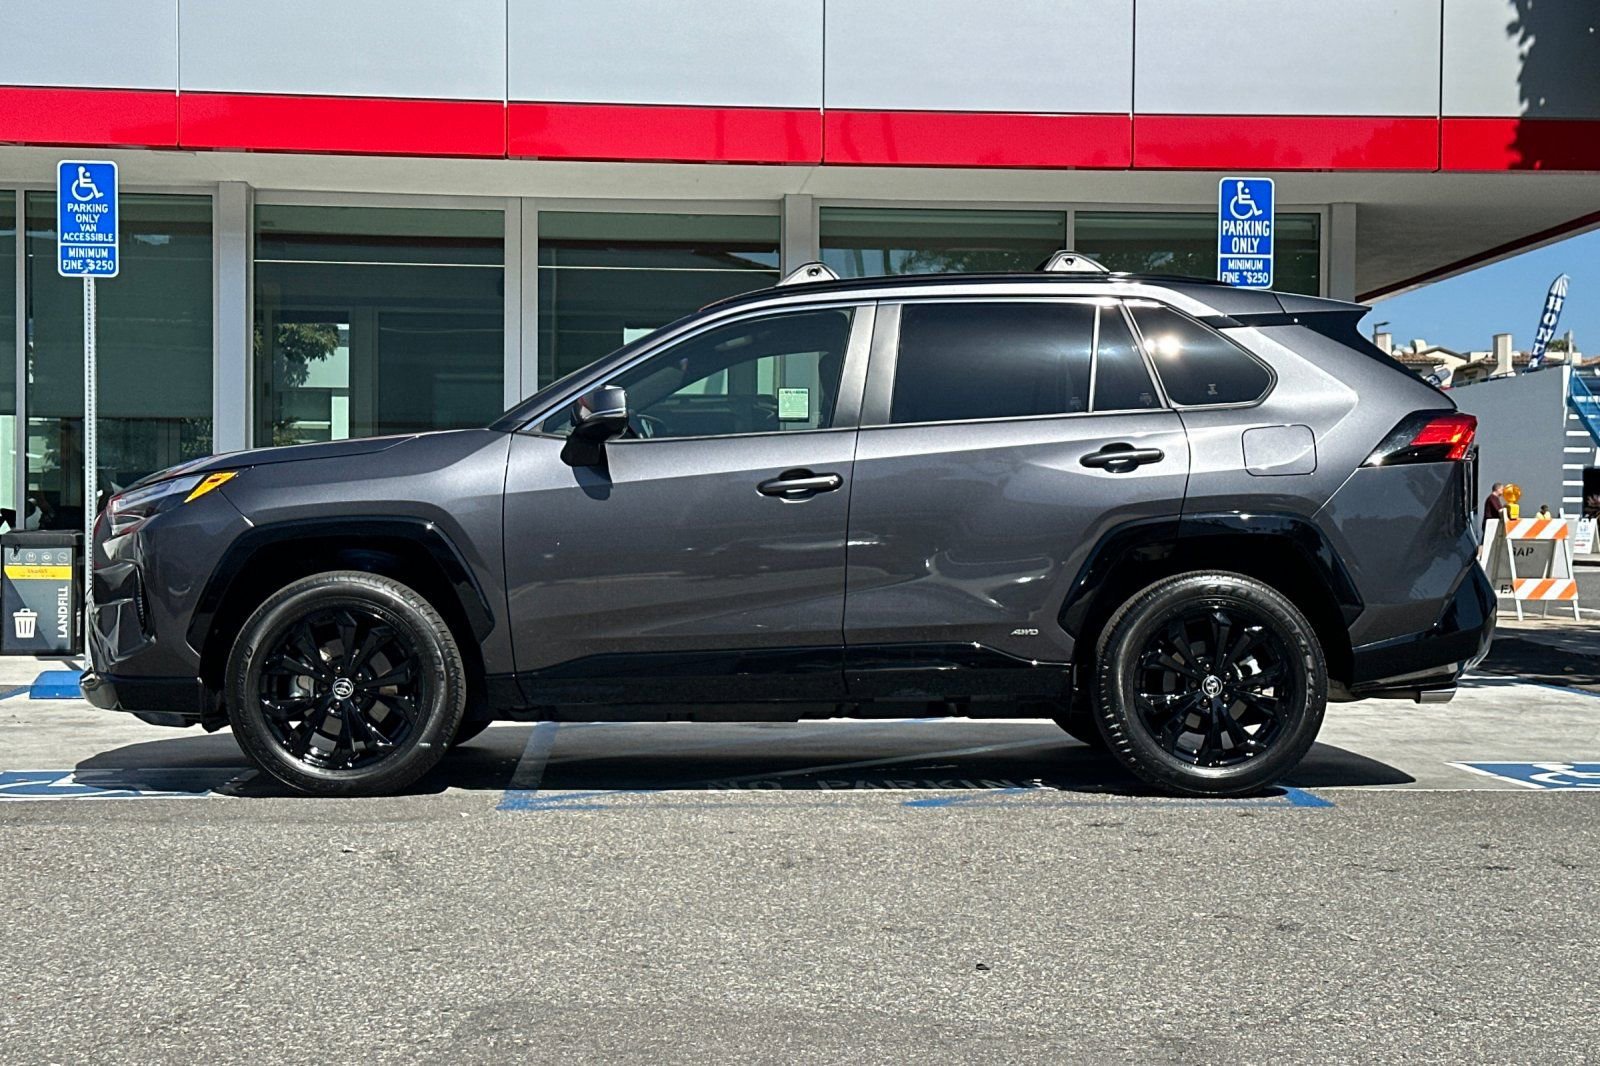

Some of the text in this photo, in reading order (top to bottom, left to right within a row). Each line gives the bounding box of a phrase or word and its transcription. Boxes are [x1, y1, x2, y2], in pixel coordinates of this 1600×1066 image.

[67, 203, 108, 213] PARKING
[75, 214, 100, 223] ONLY
[80, 224, 97, 232] VAN
[1222, 220, 1270, 236] PARKING
[63, 232, 114, 242] ACCESSIBLE
[1231, 237, 1260, 253] ONLY
[68, 247, 108, 258] MINIMUM
[62, 260, 114, 271] FINE $250
[1228, 259, 1263, 270] MINIMUM
[1221, 271, 1269, 284] FINE $250
[57, 586, 69, 638] LANDFILL
